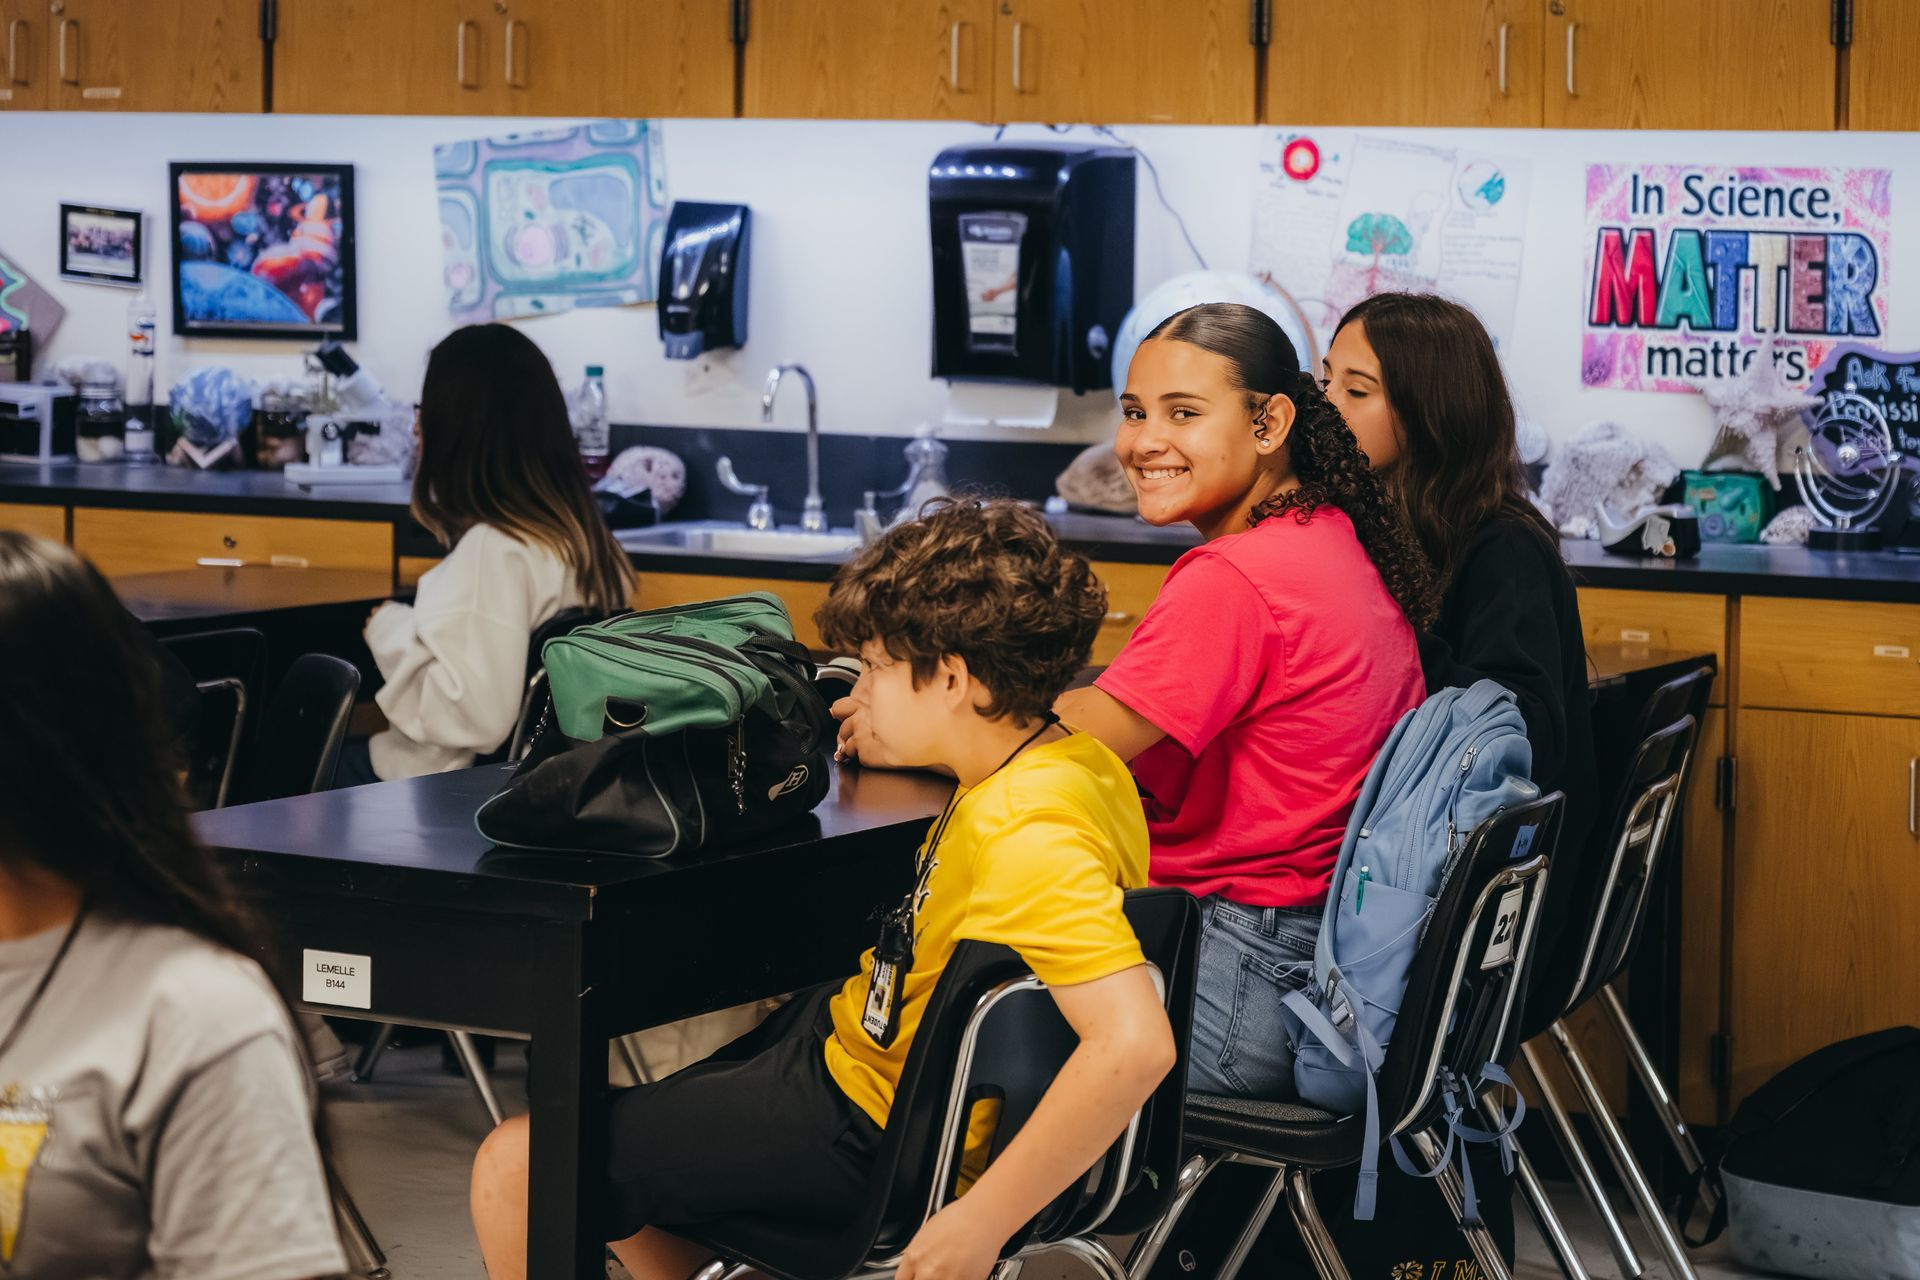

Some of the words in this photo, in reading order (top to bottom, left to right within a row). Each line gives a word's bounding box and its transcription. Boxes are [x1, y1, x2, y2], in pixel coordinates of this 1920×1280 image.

[1631, 174, 1664, 214] In
[1681, 175, 1841, 223] Science,
[1588, 227, 1881, 337] MATTER
[316, 963, 356, 977] LEMELLE
[325, 979, 346, 989] B144
